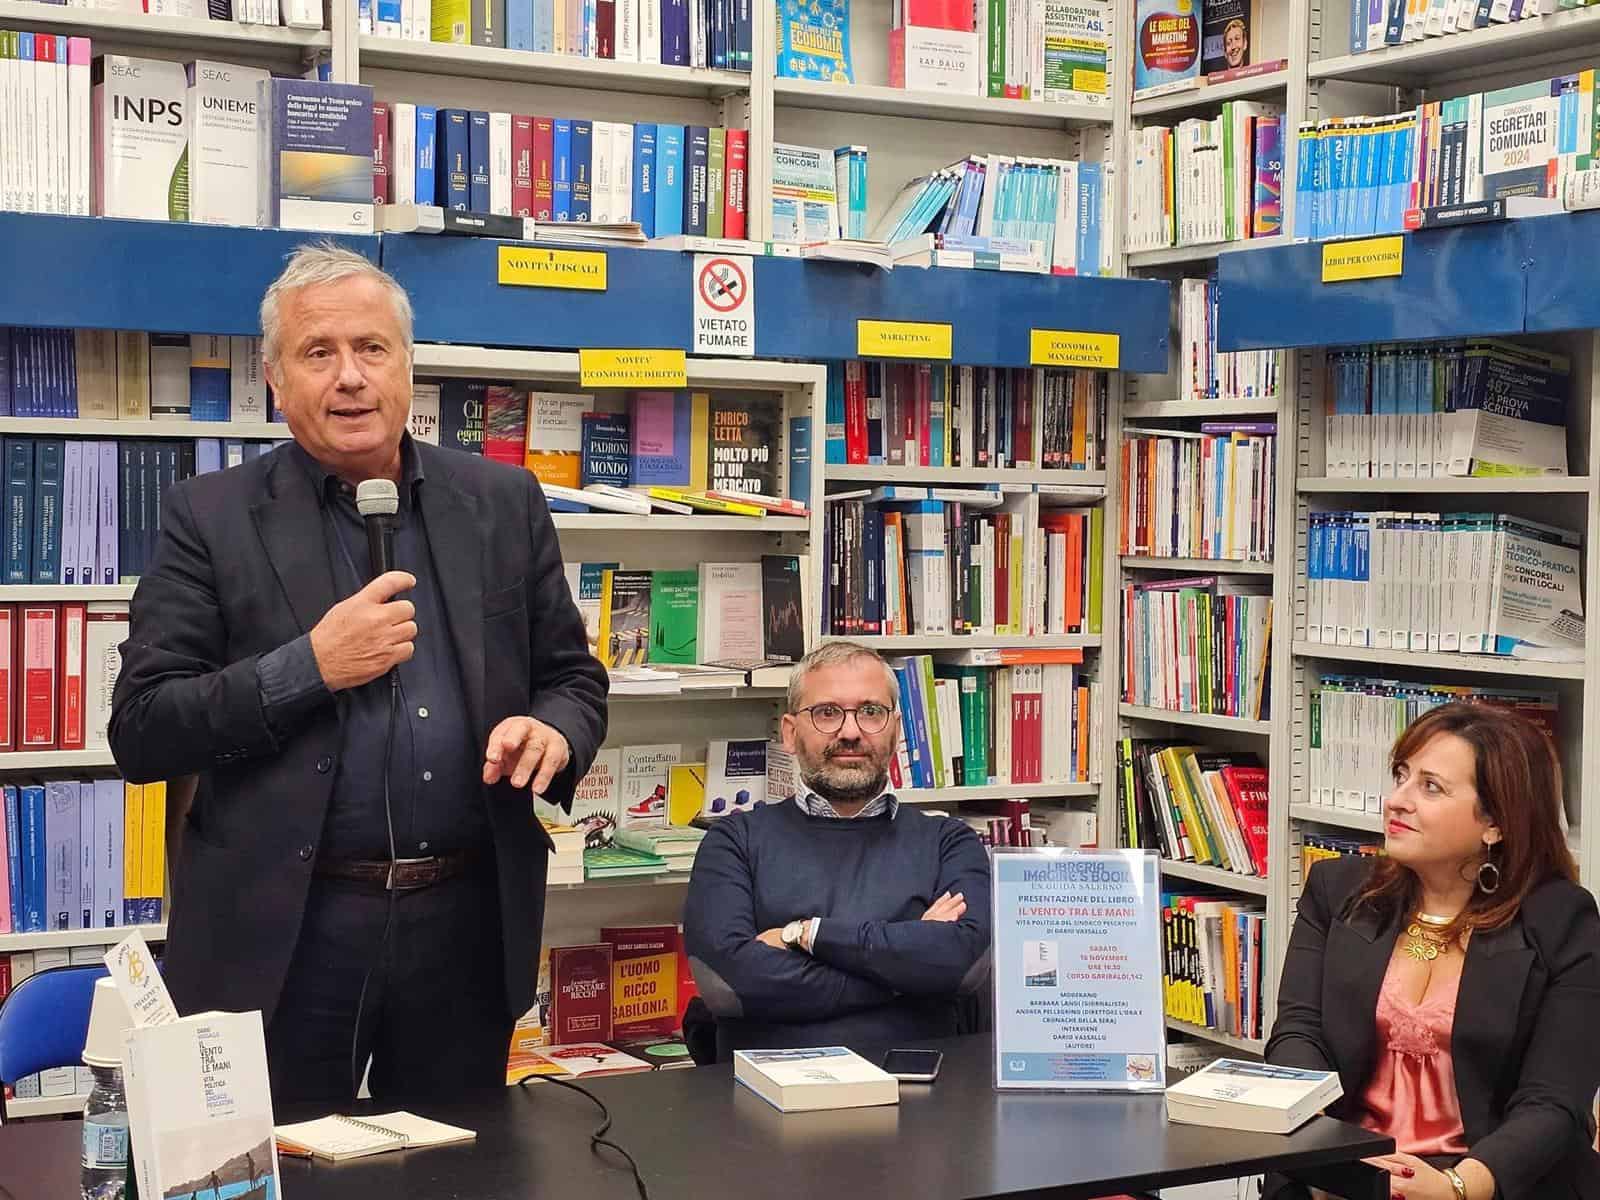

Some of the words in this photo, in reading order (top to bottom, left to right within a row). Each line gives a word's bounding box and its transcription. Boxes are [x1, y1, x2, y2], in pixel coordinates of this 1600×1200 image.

[1046, 5, 1100, 18] OLLABORATORE
[1087, 20, 1104, 32] ASL
[1150, 21, 1157, 32] LE
[1178, 18, 1190, 30] DEL
[1152, 31, 1188, 44] MARKETING
[938, 59, 966, 68] DALIO
[112, 65, 141, 78] SEAC
[202, 69, 232, 82] SEAC
[114, 94, 182, 126] INPS
[1490, 110, 1546, 136] SEGRETARI
[1490, 128, 1546, 152] COMUNALI
[776, 156, 820, 168] CONCORSI
[1504, 149, 1530, 166] 2024
[1346, 254, 1361, 265] PER
[1362, 252, 1400, 264] CONCORSI
[554, 263, 599, 274] FISCALI
[699, 318, 748, 332] VIETATO
[699, 334, 748, 346] FUMARE
[880, 332, 931, 342] MARKETING
[1050, 342, 1093, 352] ECONOMIA
[1048, 352, 1104, 362] MANAGEMENT
[1497, 395, 1528, 410] PROVA
[714, 411, 748, 426] ENRICO
[714, 427, 742, 441] LETTA
[590, 440, 628, 454] PADRONI
[714, 447, 748, 462] MOLTO
[752, 445, 768, 462] PIÙ
[590, 461, 628, 475] MONDO
[714, 463, 726, 478] DI
[728, 462, 743, 478] UN
[714, 478, 762, 492] MERCATO
[1506, 551, 1576, 574] TEORICO-PRATICA
[1514, 566, 1552, 580] CONCORSI
[1520, 576, 1536, 586] ENTI
[1537, 580, 1564, 592] LOCALI
[628, 754, 676, 764] Contraffatto
[590, 764, 608, 775] ARIO
[640, 764, 656, 772] arte
[579, 777, 596, 788] IMO
[598, 776, 614, 786] NON
[576, 786, 608, 800] SALVERÀ
[1048, 862, 1104, 873] LIBRERIA
[1018, 896, 1088, 904] PRESENTAZIONE
[1018, 908, 1028, 916] IL
[1031, 908, 1065, 916] VENTO
[1068, 908, 1088, 916] TRA
[1091, 908, 1102, 916] LE
[1105, 908, 1135, 916] MANI
[620, 960, 660, 978] L'UOMO
[562, 982, 606, 992] DIVENTARE
[624, 981, 656, 998] RICCO
[570, 991, 597, 1000] RICCHI
[612, 998, 668, 1020] BABILONIA
[200, 1046, 222, 1056] VENTO
[201, 1056, 215, 1064] TRA
[202, 1064, 211, 1074] LE
[212, 1061, 232, 1072] MANI
